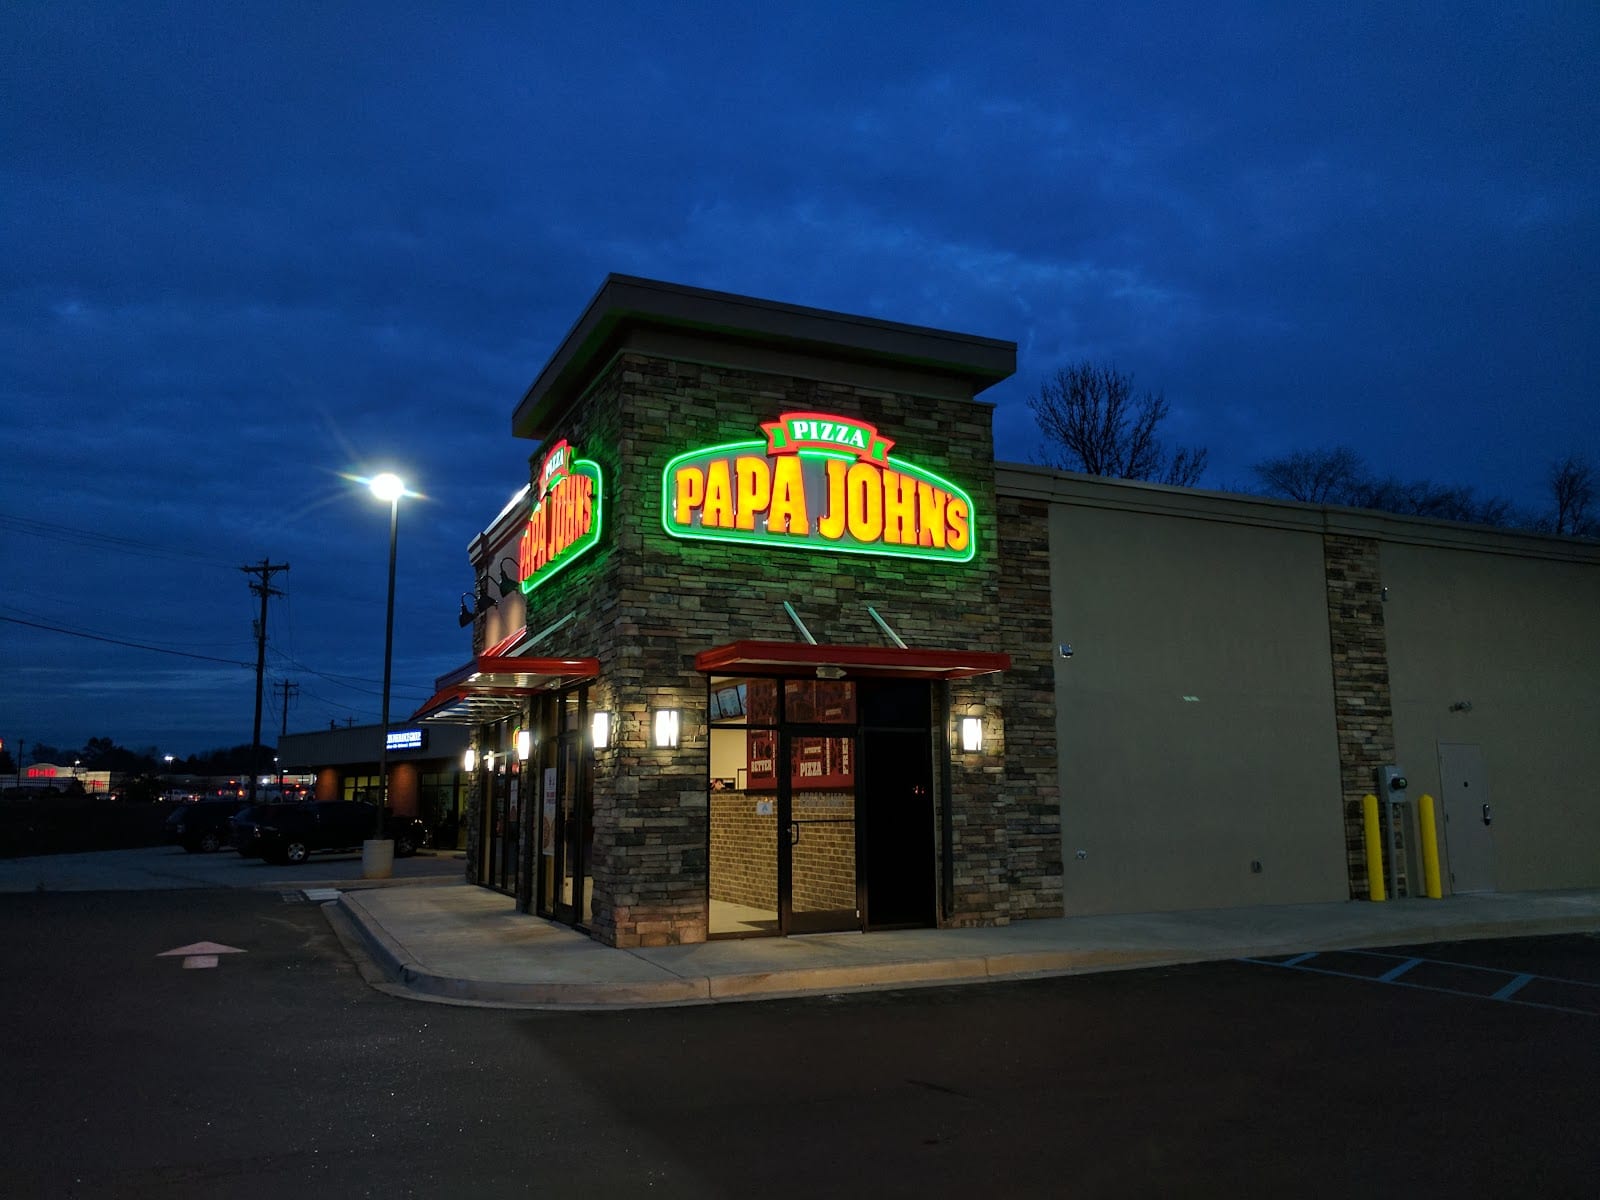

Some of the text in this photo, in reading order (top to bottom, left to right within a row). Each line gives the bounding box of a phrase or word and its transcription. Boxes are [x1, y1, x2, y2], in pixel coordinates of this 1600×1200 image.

[792, 420, 866, 448] PIZZA
[676, 456, 969, 552] PAPA JOHN'S
[519, 495, 547, 583] PAPA
[800, 761, 822, 777] PIZZA
